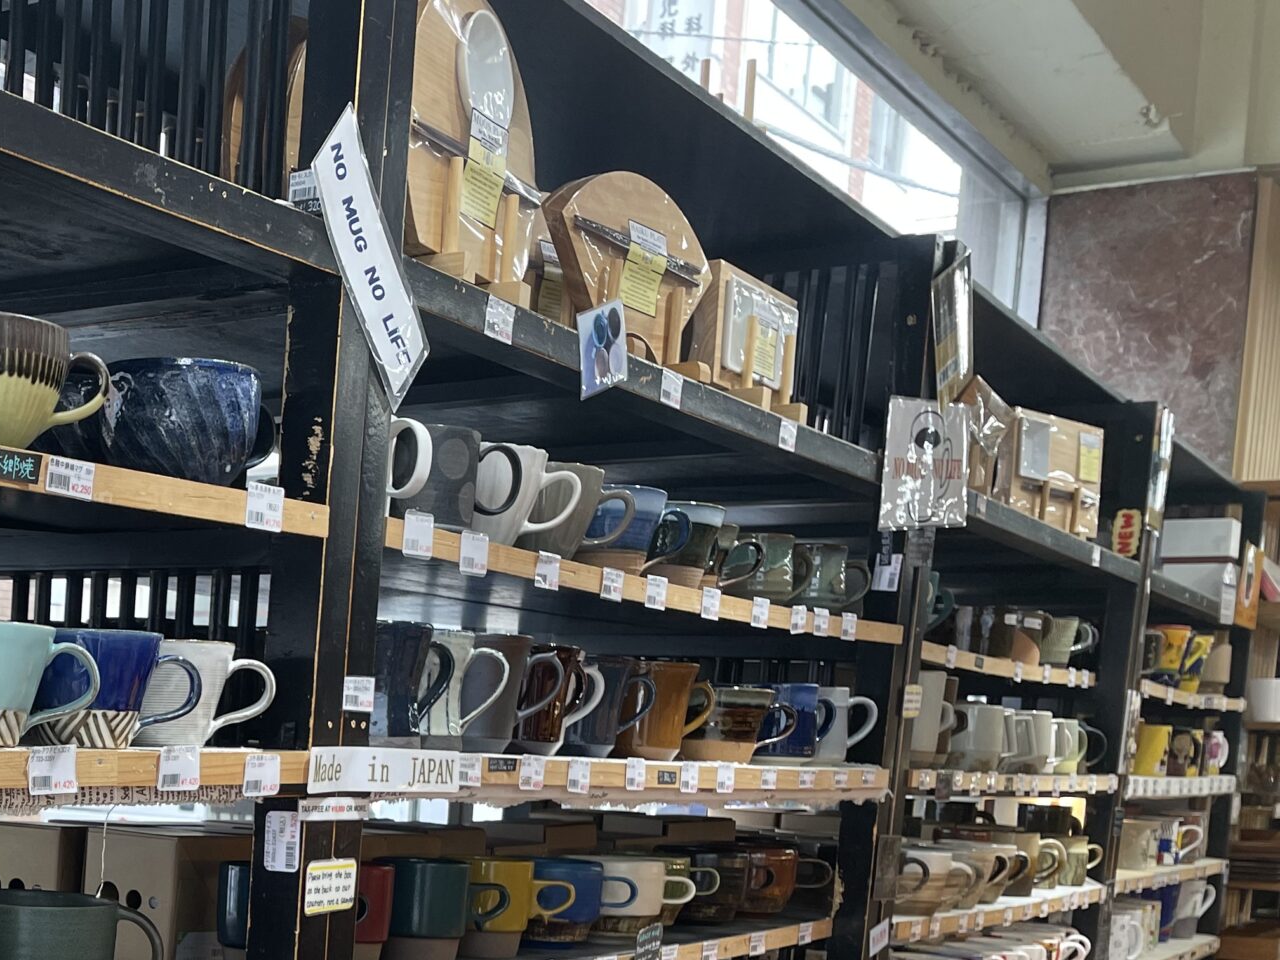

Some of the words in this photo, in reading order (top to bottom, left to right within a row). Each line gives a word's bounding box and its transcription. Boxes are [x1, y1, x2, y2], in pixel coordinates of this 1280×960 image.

[330, 142, 347, 181] NO
[342, 195, 367, 253] MUG
[364, 265, 386, 301] NO
[71, 483, 92, 495] ¥2,250
[1116, 512, 1134, 554] NEW
[313, 756, 342, 783] Made
[367, 755, 390, 783] in
[408, 757, 455, 787] JAPAN
[301, 805, 324, 813] TAX-FREE
[324, 805, 331, 813] AT
[346, 805, 353, 813] OR
